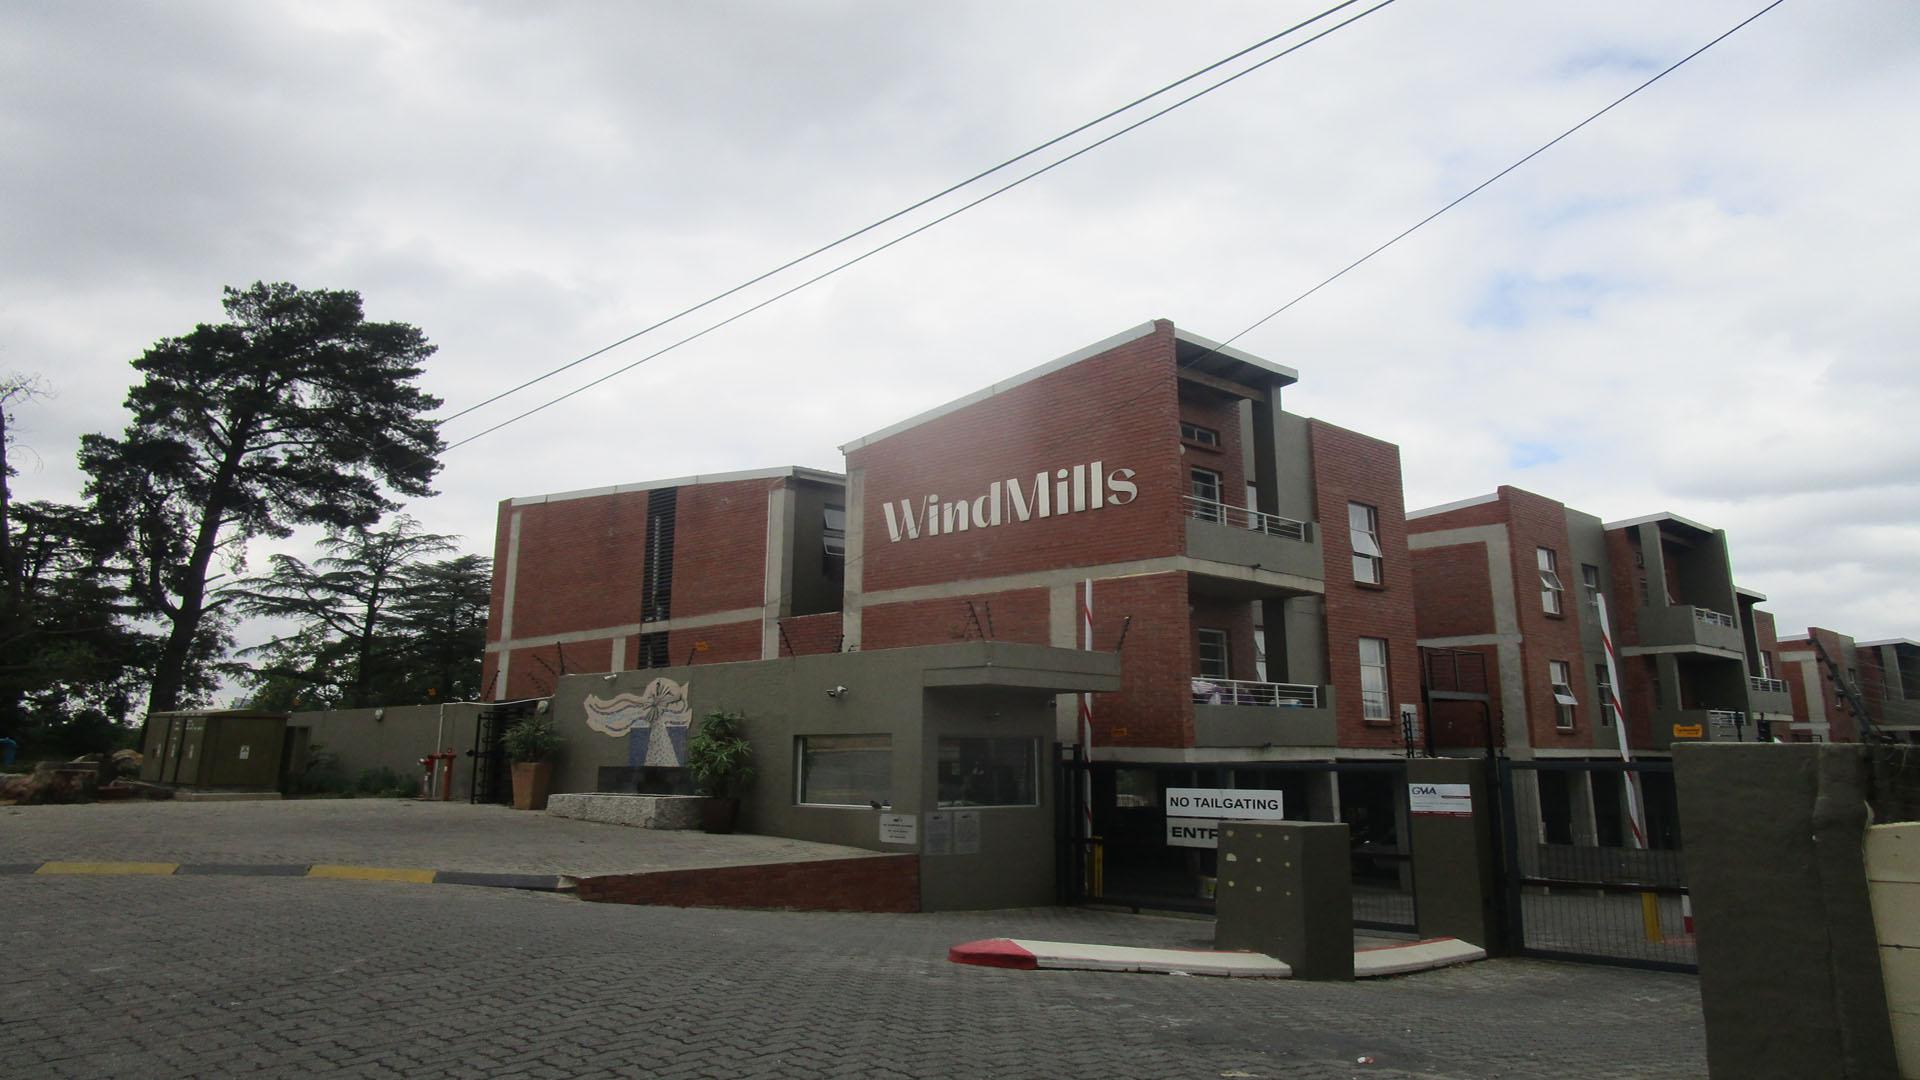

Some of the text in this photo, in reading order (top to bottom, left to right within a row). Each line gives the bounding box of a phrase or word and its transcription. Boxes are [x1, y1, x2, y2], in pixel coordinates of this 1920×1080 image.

[883, 461, 1138, 543] WindMills
[1170, 797, 1279, 810] NO TAILGATING
